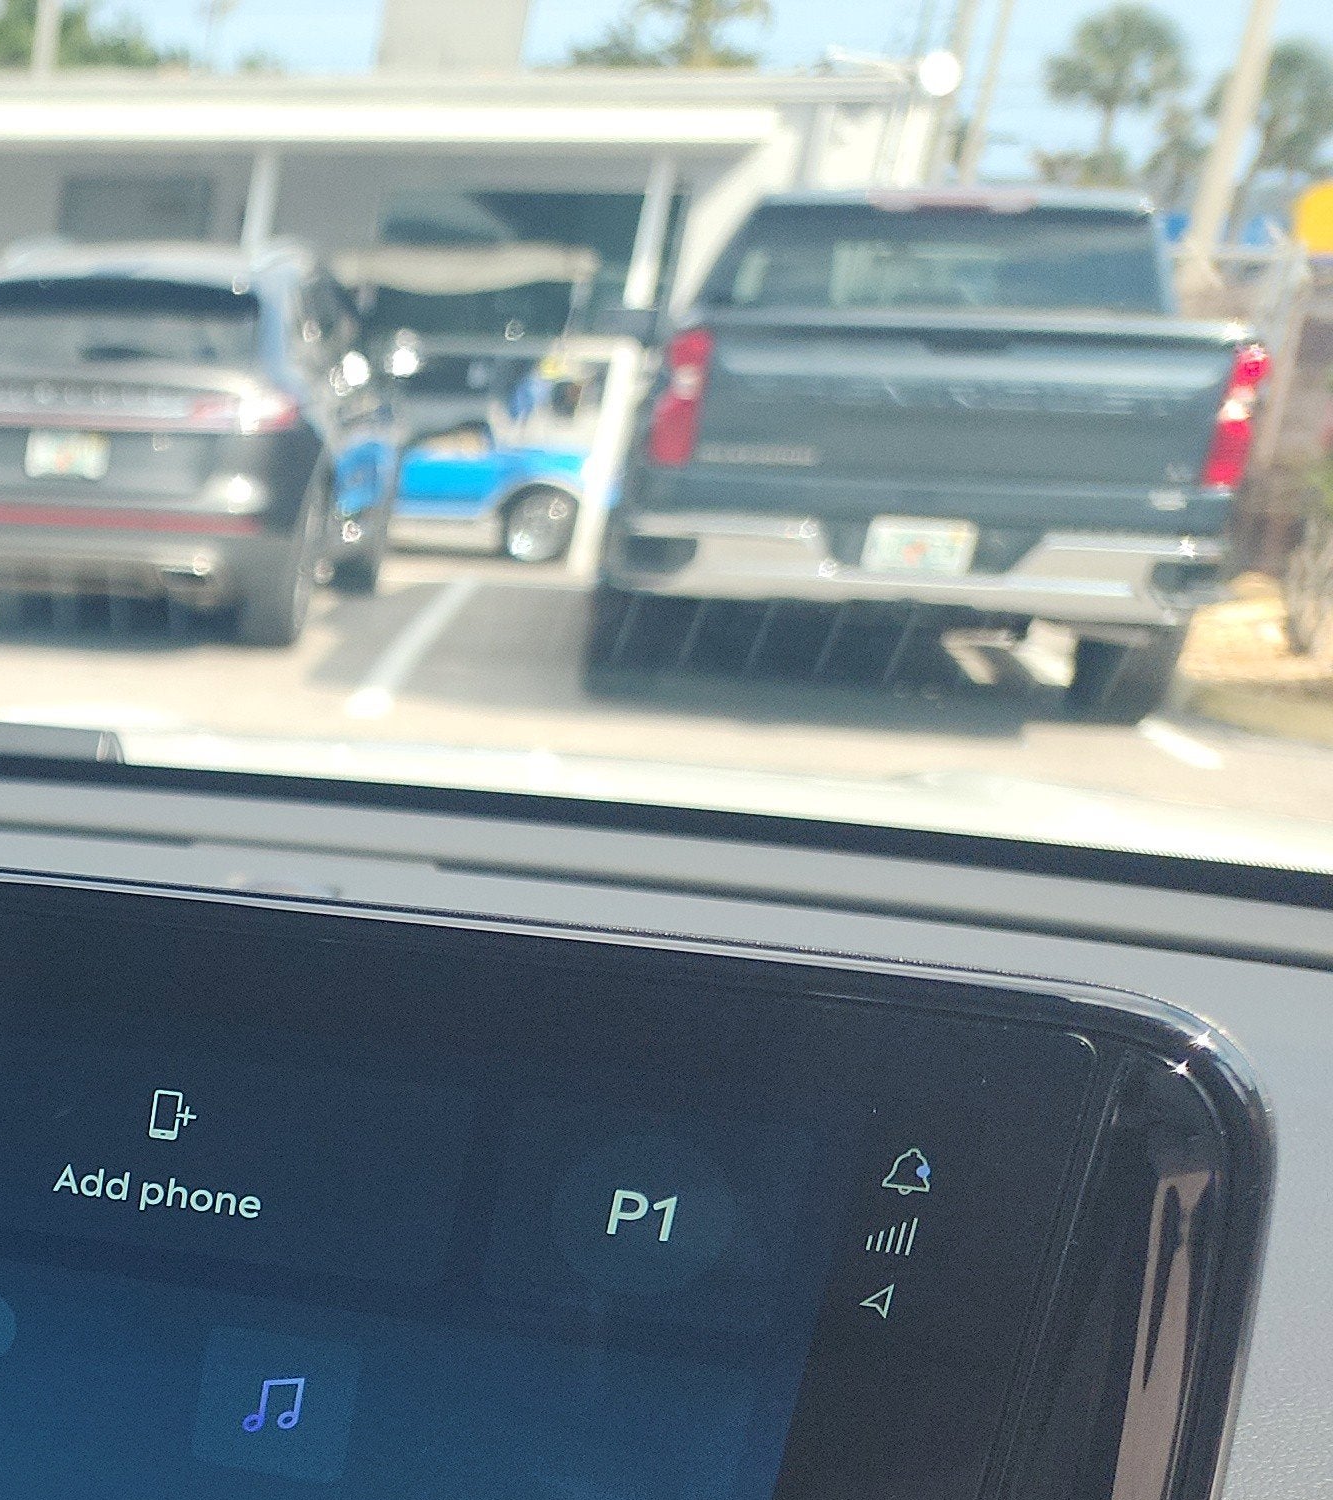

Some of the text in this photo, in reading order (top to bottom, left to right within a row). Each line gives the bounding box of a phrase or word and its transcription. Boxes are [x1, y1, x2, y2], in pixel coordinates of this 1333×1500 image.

[51, 1160, 263, 1222] Add phone
[604, 1188, 680, 1244] P1
